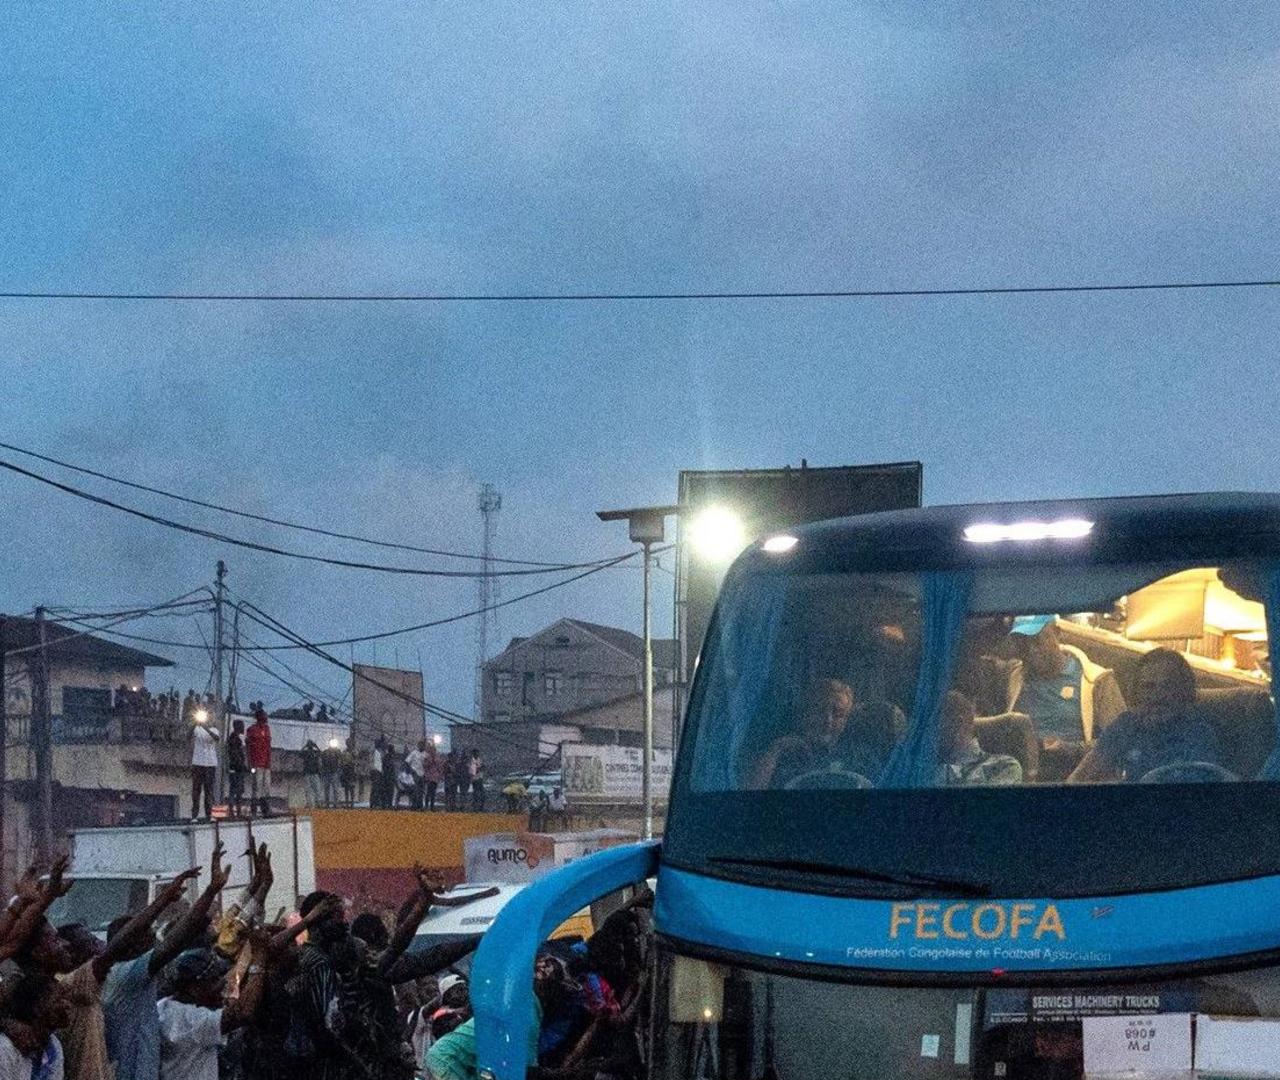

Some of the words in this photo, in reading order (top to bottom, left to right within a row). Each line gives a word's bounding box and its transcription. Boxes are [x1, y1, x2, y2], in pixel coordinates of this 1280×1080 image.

[889, 902, 1066, 940] FECOFA
[909, 946, 971, 961] Congolaise
[975, 947, 990, 958] de
[993, 947, 1040, 959] Football
[1043, 947, 1111, 962] Association
[1032, 995, 1072, 1008] SERVICES
[1075, 995, 1121, 1008] MACHINERY
[1126, 994, 1160, 1008] TRUCKS
